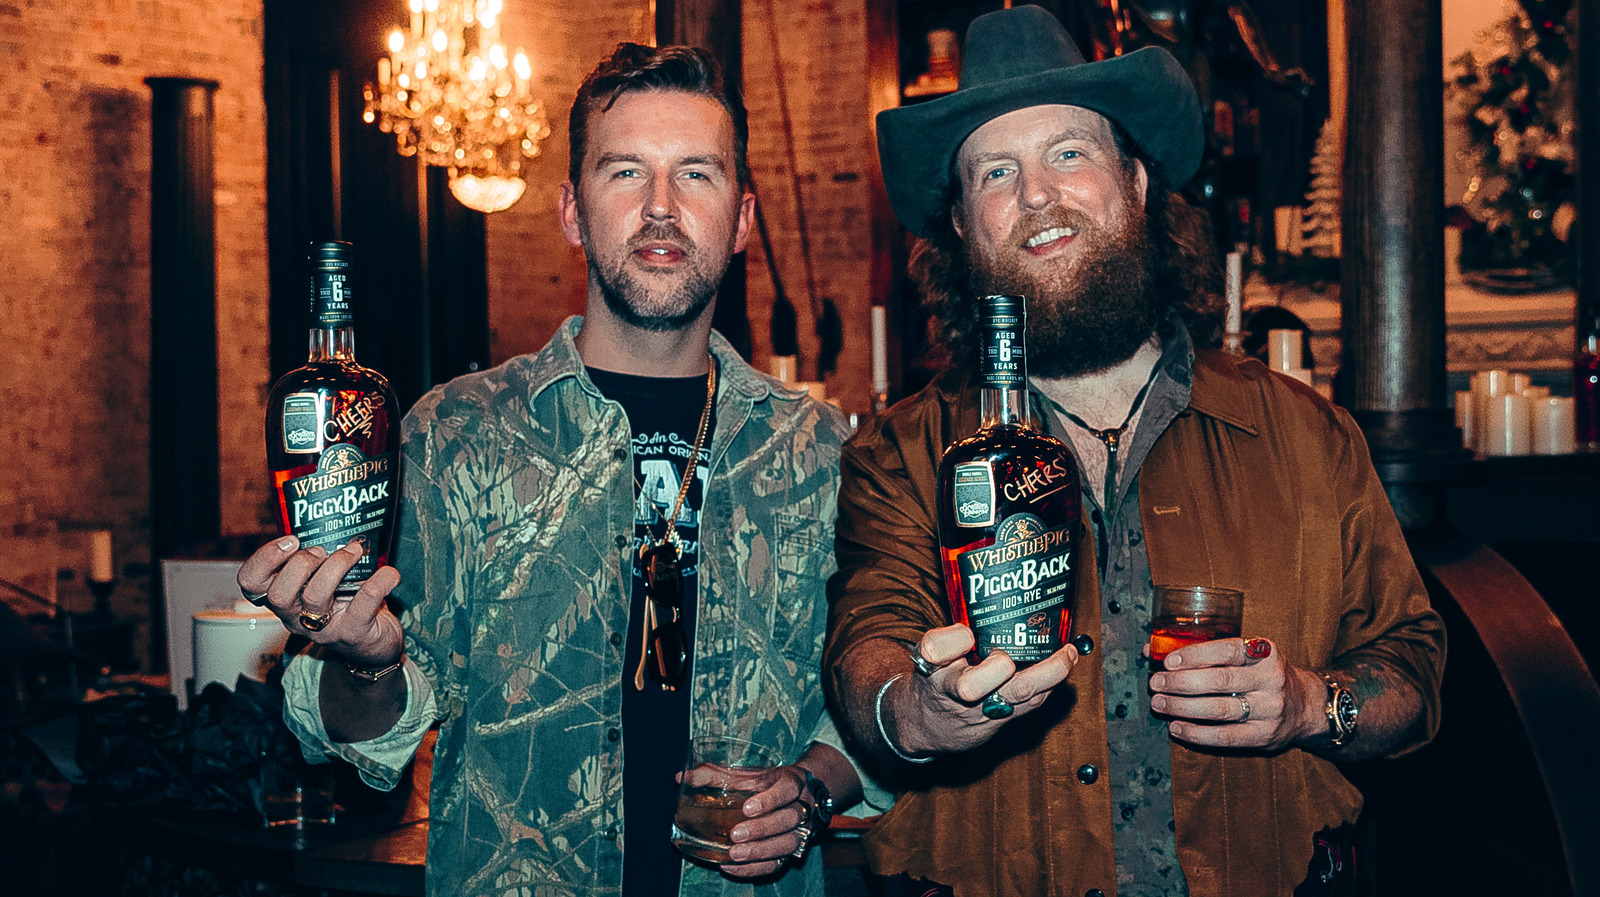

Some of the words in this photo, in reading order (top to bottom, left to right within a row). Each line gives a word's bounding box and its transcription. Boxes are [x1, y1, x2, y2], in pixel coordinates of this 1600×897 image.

[328, 274, 347, 282] AGED
[332, 281, 344, 302] 6
[326, 302, 349, 310] YEARS
[999, 339, 1011, 361] 6
[993, 362, 1018, 370] YEARS
[323, 390, 386, 442] CHEERS
[649, 431, 668, 444] An
[1003, 458, 1067, 501] CHEERS
[325, 519, 344, 533] 100%
[344, 512, 362, 527] RYE
[972, 607, 985, 616] SMALL
[984, 604, 997, 613] BATCH
[1002, 595, 1023, 610] 100%
[1024, 588, 1042, 604] RYE
[1056, 582, 1067, 592] PROOF
[980, 617, 1000, 625] SINGLE
[1002, 609, 1023, 619] BARREL
[1025, 605, 1036, 613] RYE
[1038, 597, 1061, 609] WHISKEY
[990, 635, 1012, 644] AGED
[1014, 622, 1027, 647] 6
[1028, 634, 1050, 644] YEARS
